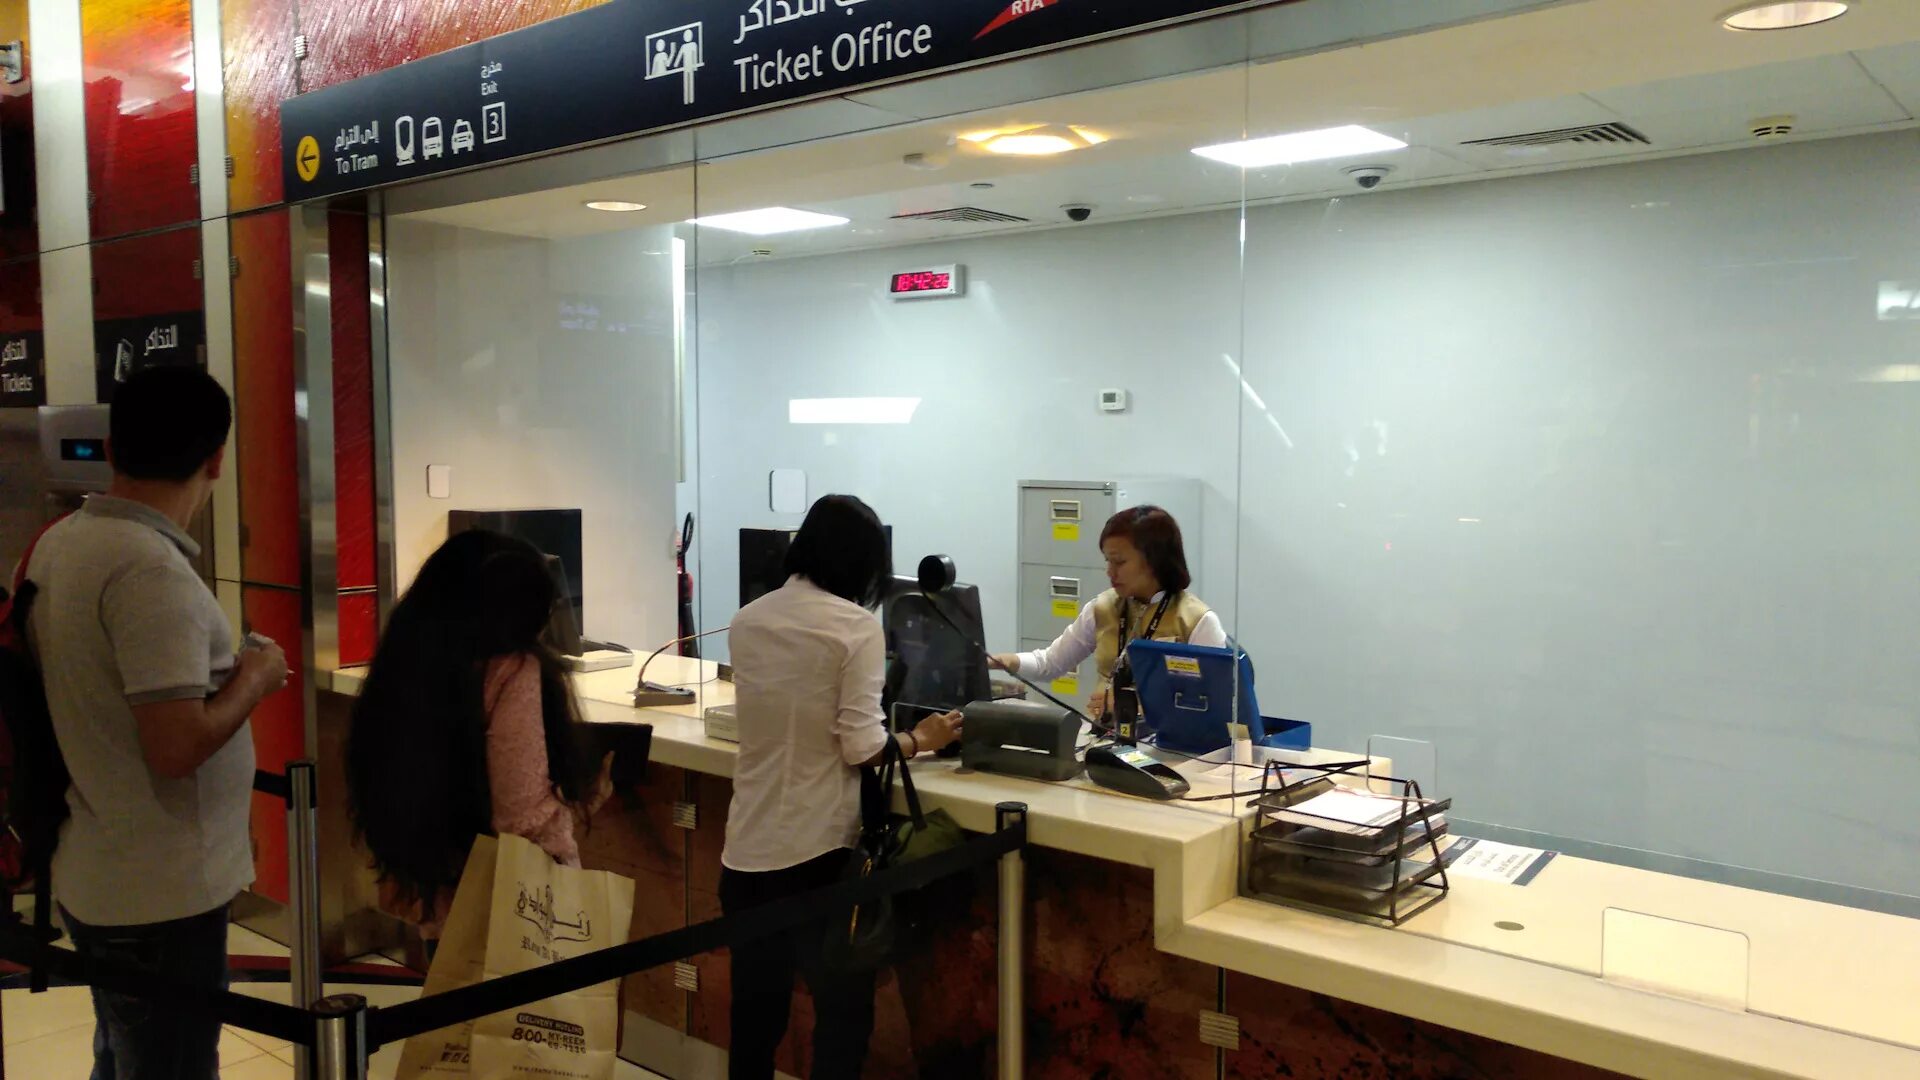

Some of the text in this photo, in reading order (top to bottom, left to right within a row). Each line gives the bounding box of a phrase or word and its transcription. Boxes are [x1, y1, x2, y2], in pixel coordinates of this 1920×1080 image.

[1011, 0, 1045, 15] RTA
[733, 20, 932, 93] Ticket Office
[480, 61, 503, 79] مخرج
[480, 80, 499, 96] Exit
[489, 111, 500, 135] 3
[335, 154, 379, 175] To Tram
[143, 324, 179, 357] التذاكر
[1, 373, 34, 393] Tickets
